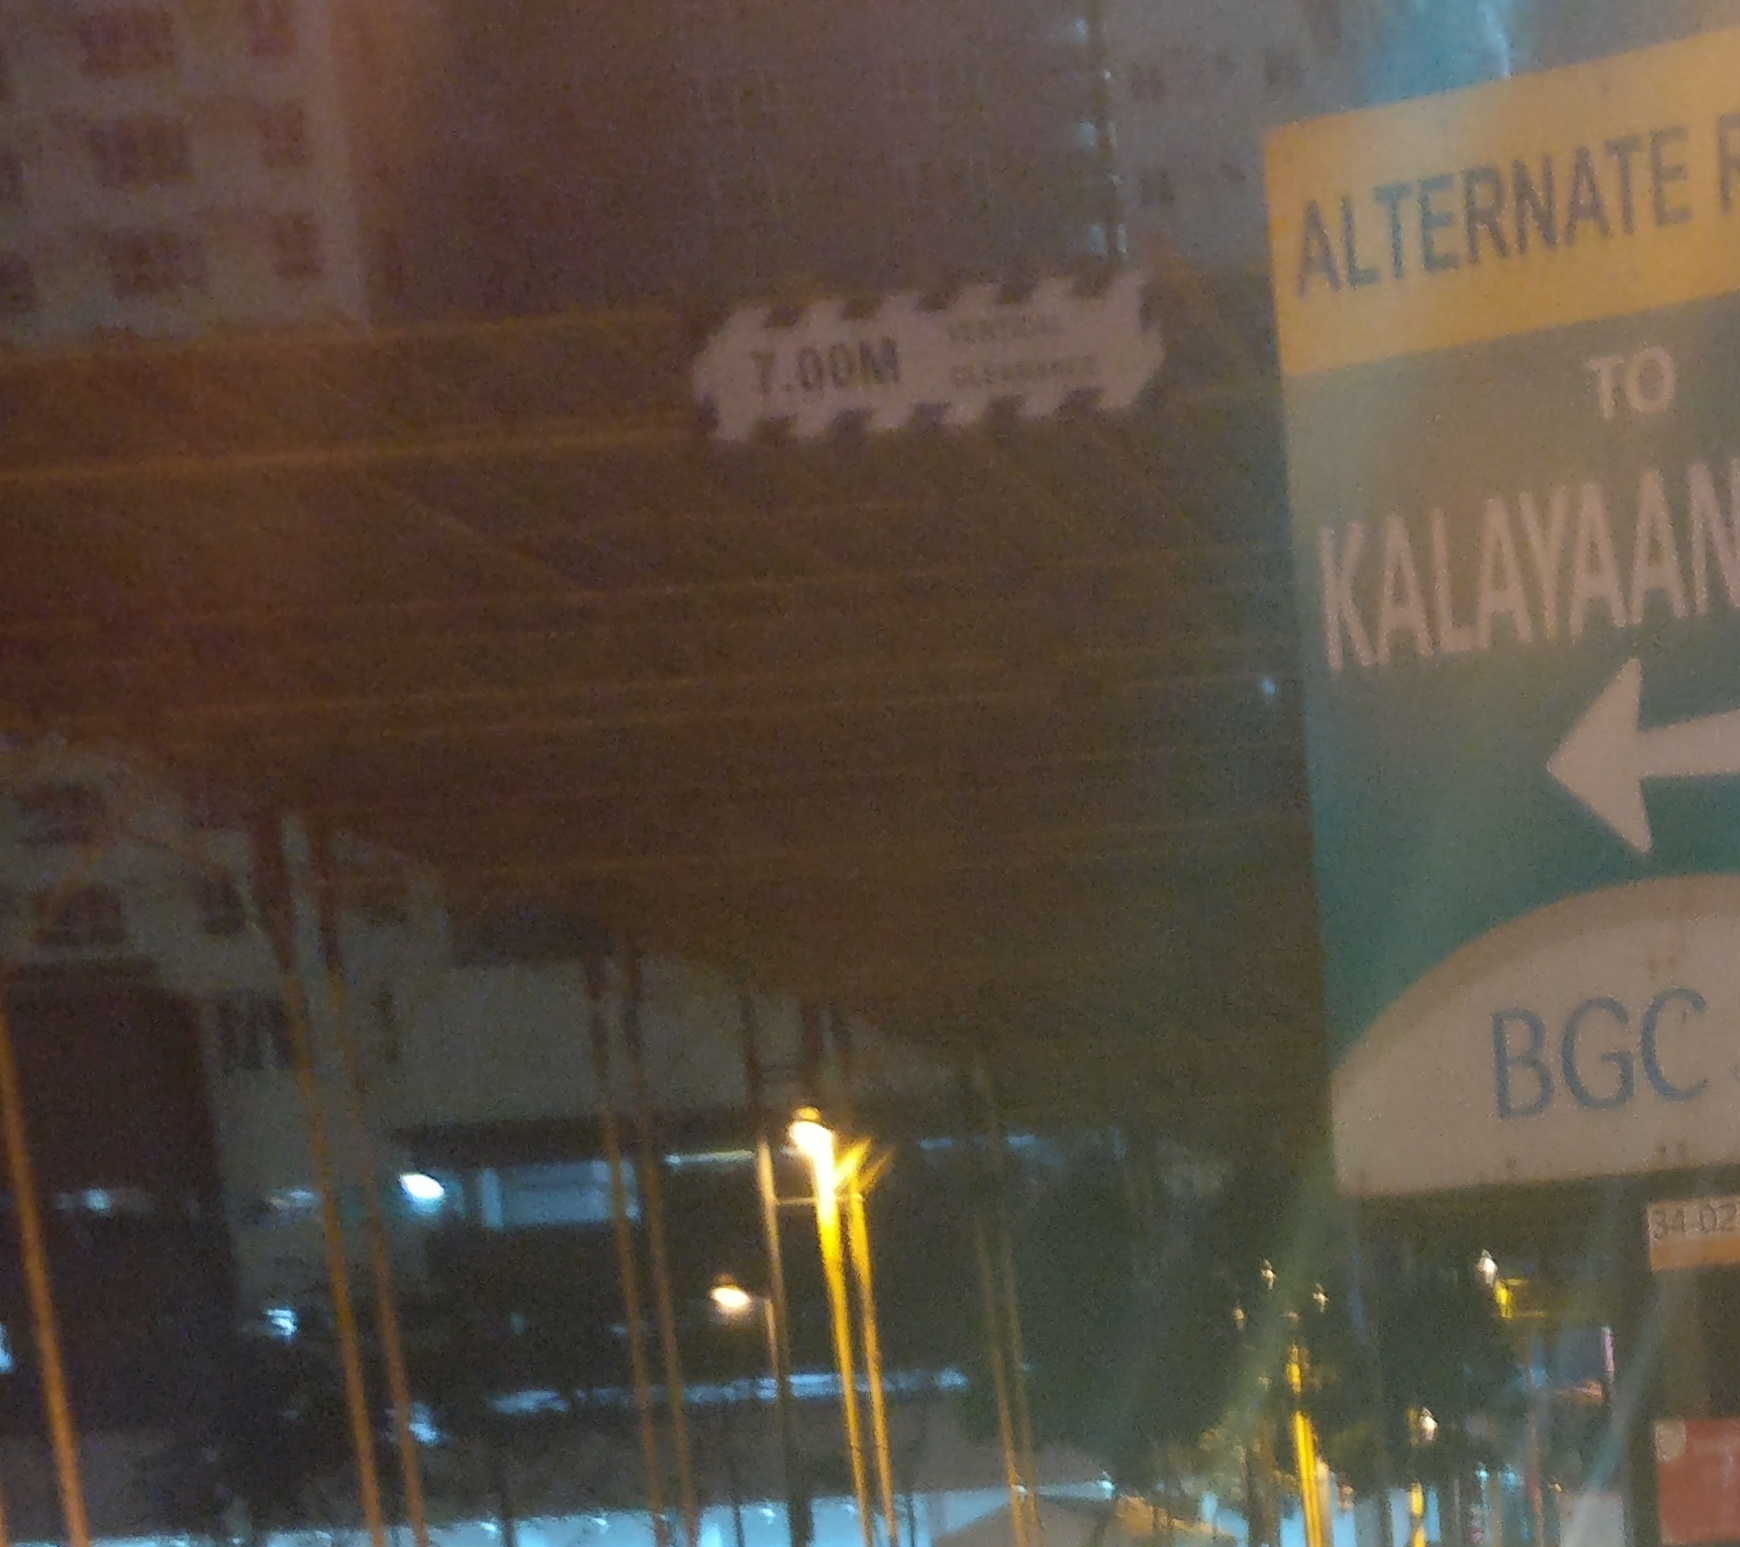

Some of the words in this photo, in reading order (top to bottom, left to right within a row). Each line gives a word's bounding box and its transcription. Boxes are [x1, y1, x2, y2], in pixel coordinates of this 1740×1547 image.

[1296, 125, 1692, 298] ALTERNATE
[1586, 346, 1679, 420] TO
[1489, 987, 1709, 1120] BGC
